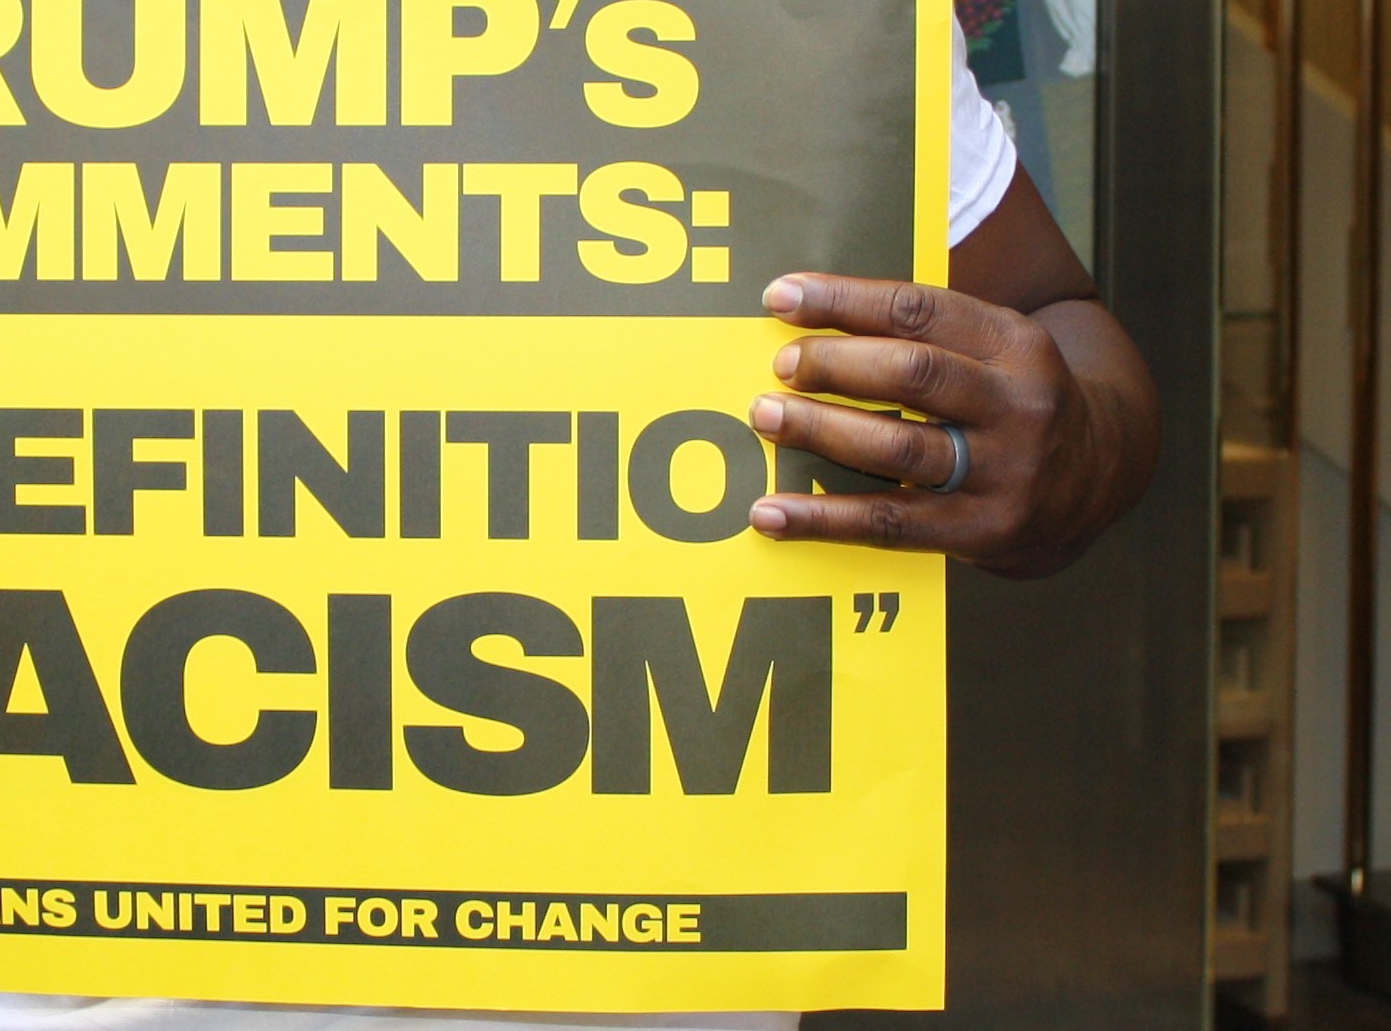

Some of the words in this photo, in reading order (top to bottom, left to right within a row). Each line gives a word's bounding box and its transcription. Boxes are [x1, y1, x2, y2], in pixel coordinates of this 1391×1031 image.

[93, 889, 308, 935] UNITED
[324, 897, 439, 938] FOR
[454, 899, 702, 943] CHANGE
